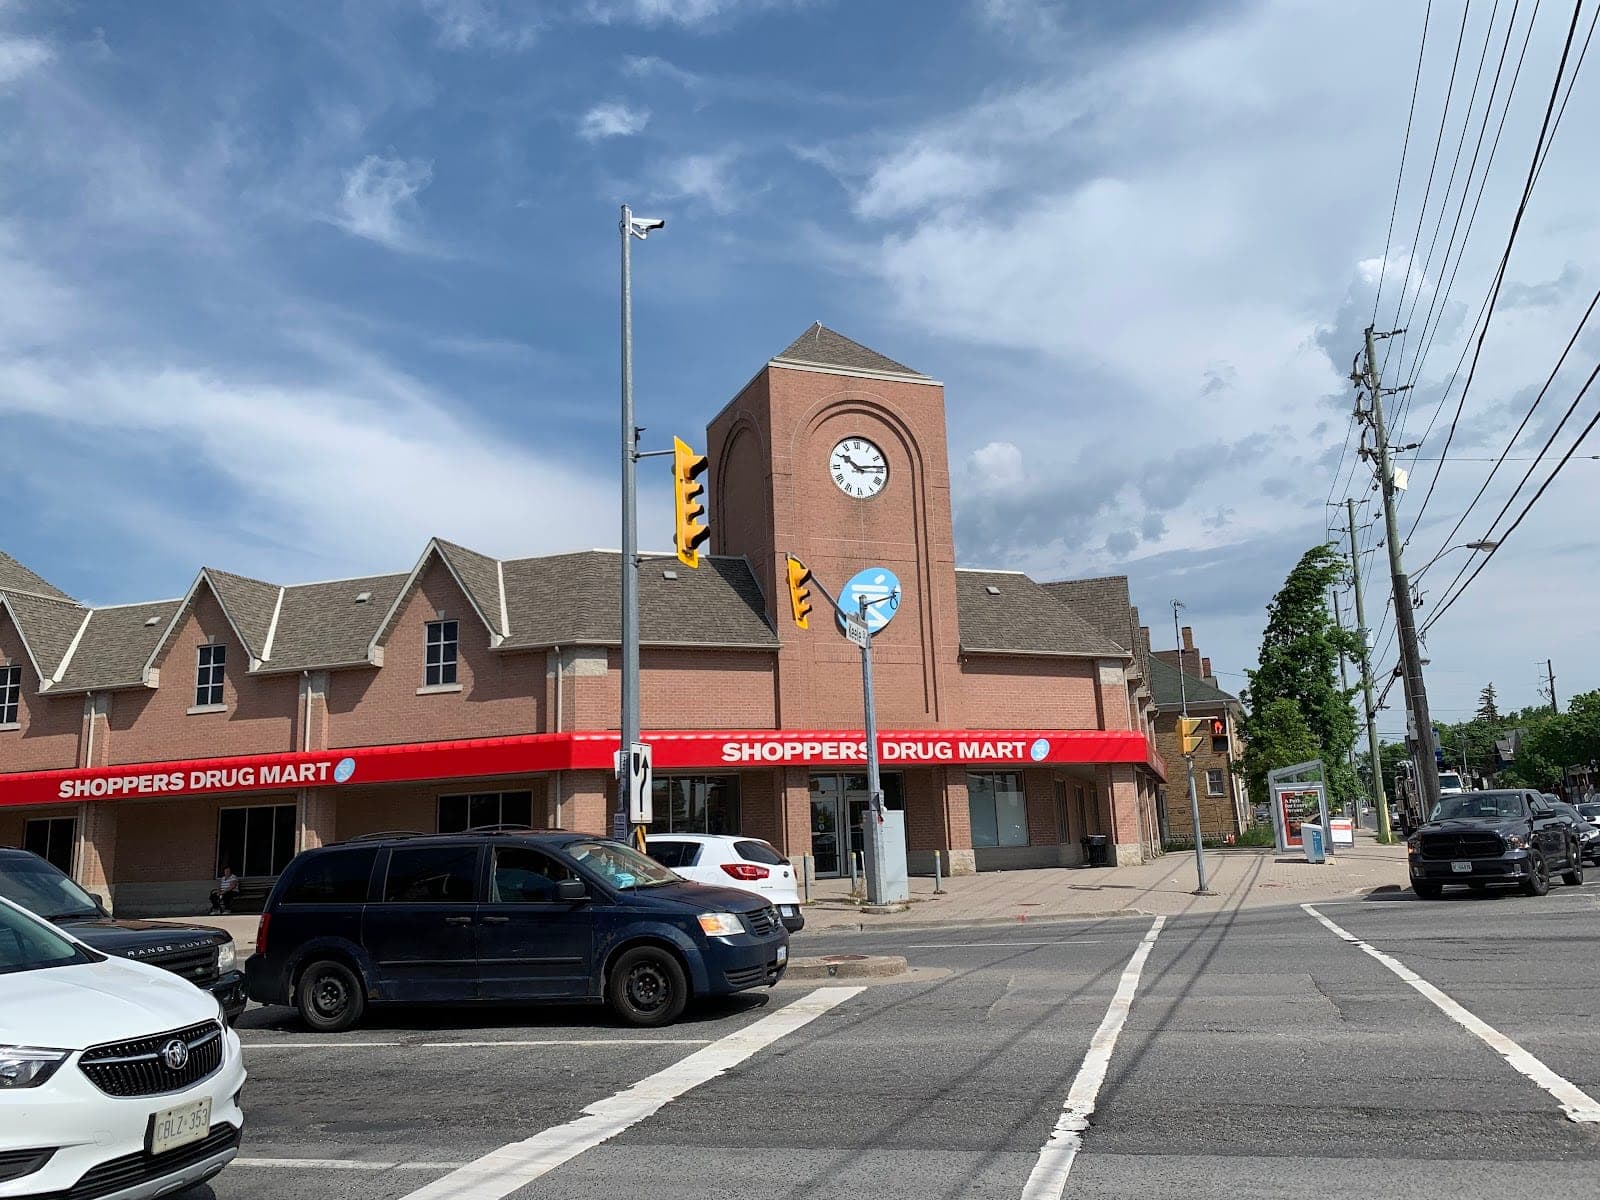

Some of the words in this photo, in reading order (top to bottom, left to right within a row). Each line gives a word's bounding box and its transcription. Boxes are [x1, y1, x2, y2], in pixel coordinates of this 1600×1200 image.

[882, 741, 952, 760] DRUG
[959, 741, 1026, 759] MART
[58, 772, 185, 798] SHOPPERS
[190, 767, 255, 790] DRUG
[259, 762, 331, 785] MART
[127, 945, 172, 958] RANGE
